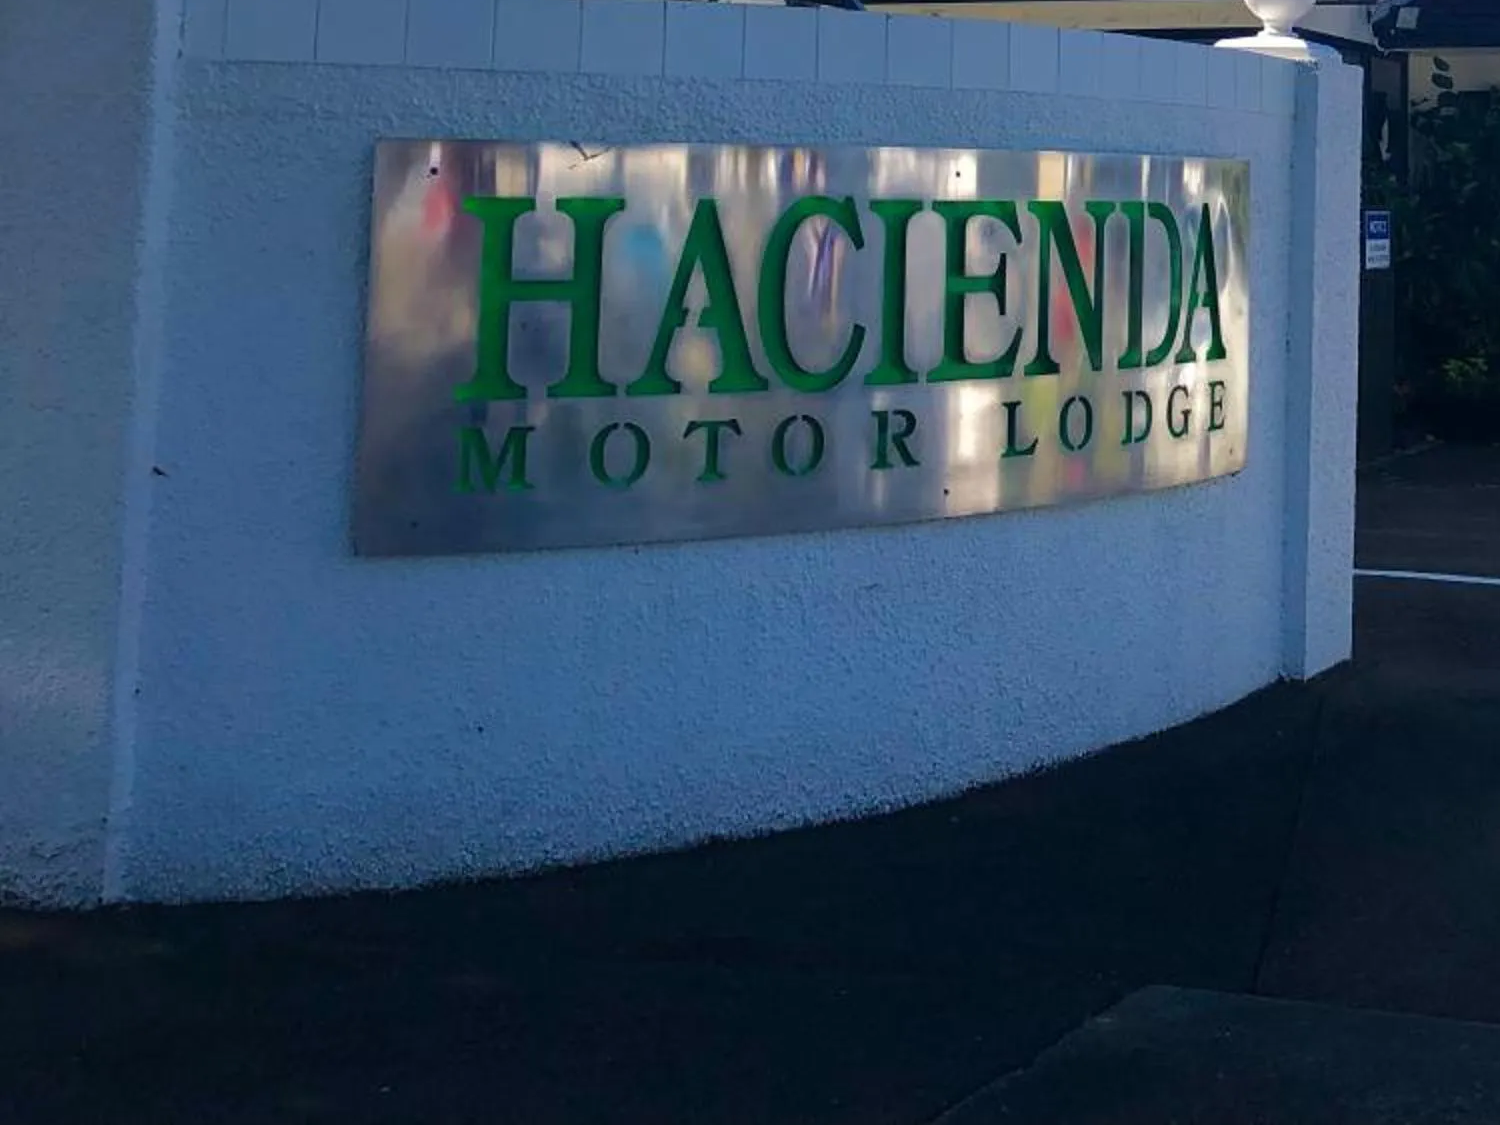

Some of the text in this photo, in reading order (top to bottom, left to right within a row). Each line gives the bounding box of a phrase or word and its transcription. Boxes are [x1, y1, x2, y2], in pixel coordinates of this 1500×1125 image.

[454, 195, 1229, 403] HACIENDA
[454, 378, 1228, 493] MOTOR LODGE
